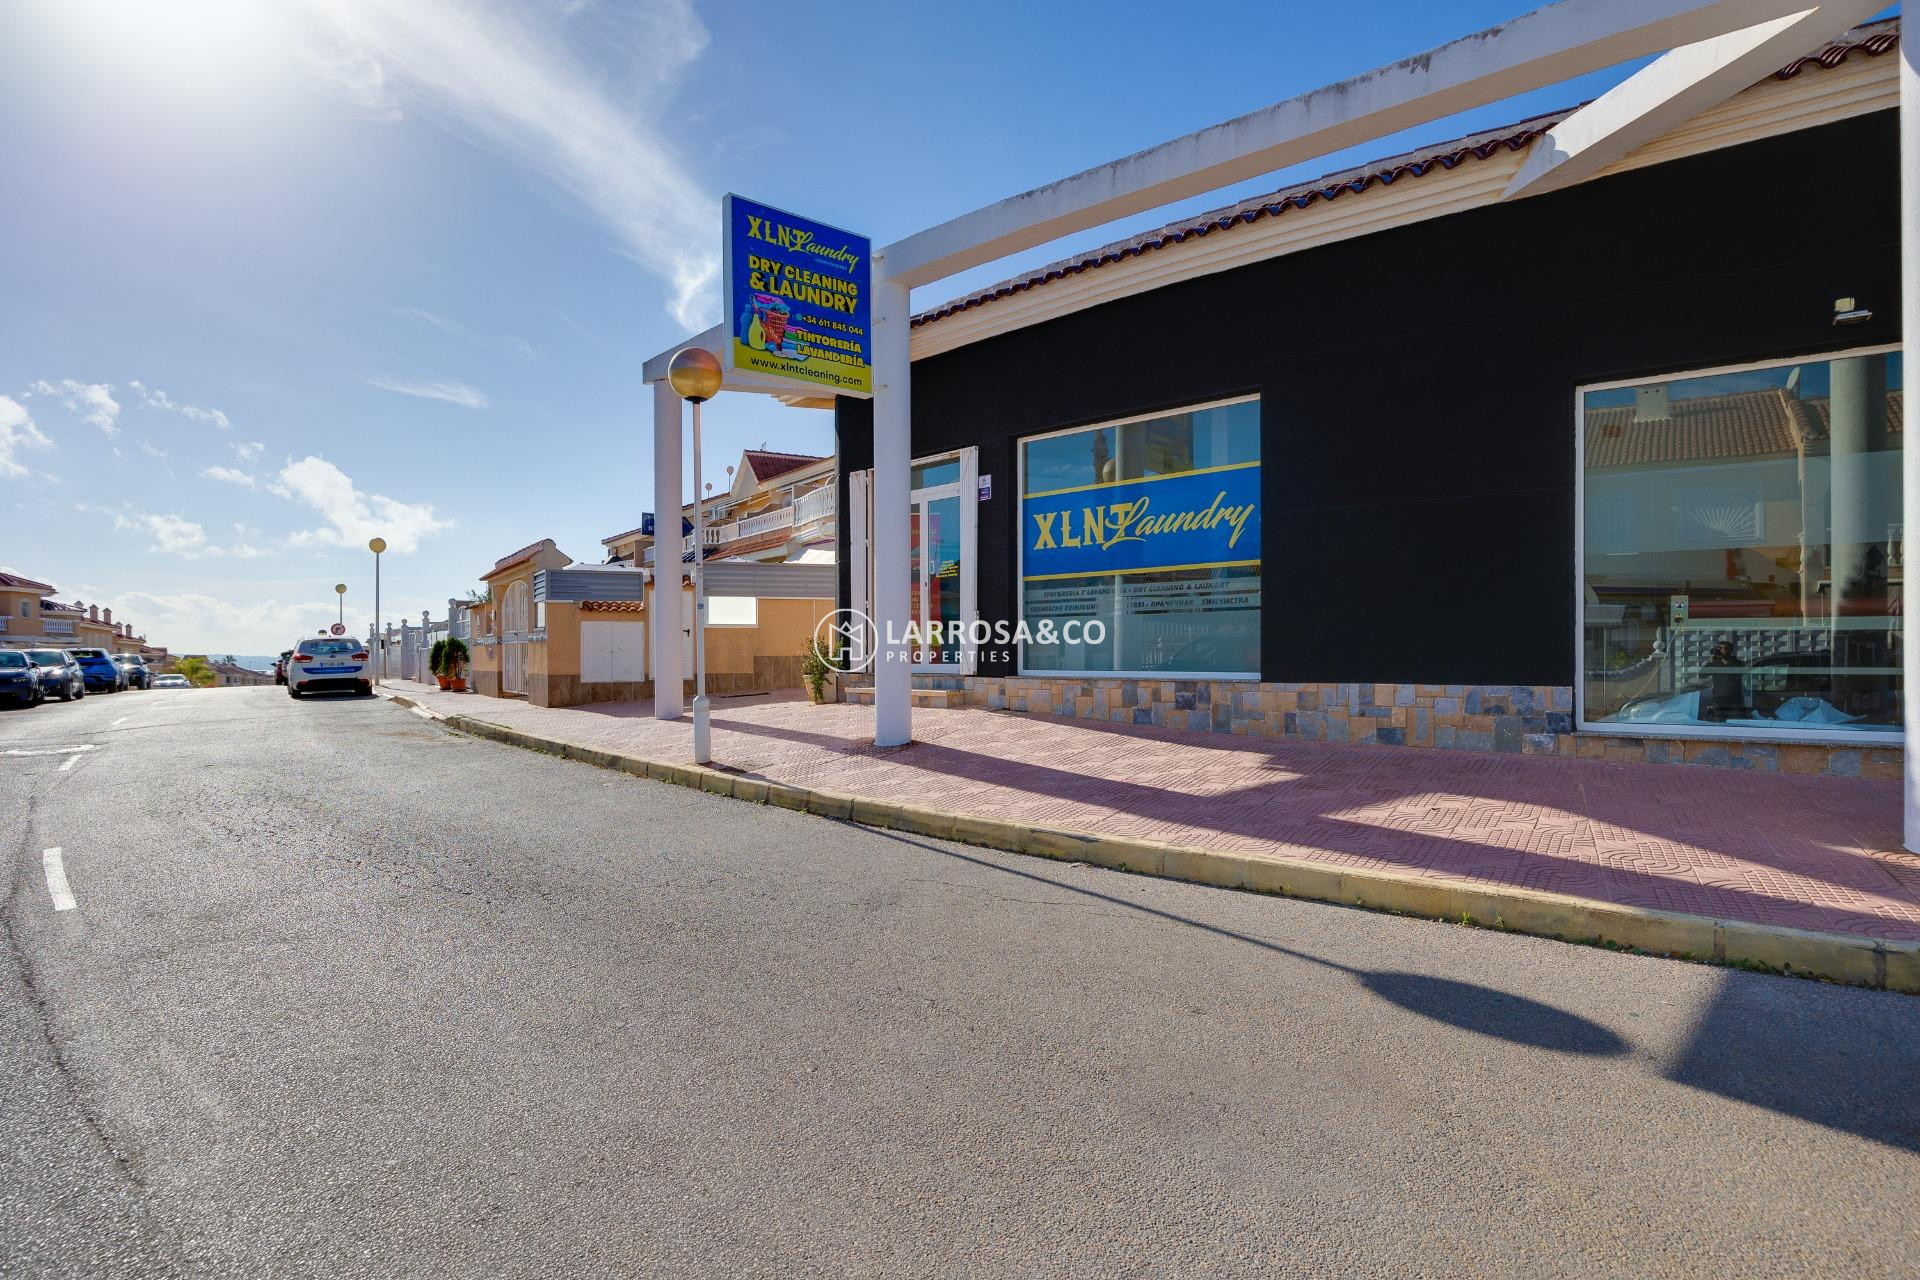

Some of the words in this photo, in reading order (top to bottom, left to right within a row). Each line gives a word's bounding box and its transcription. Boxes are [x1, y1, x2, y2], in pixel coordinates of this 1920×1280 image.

[788, 231, 859, 274] Laundry
[749, 255, 781, 275] DRY
[784, 265, 858, 296] CLEANING
[749, 271, 765, 291] &
[769, 276, 858, 314] LAUNDRY
[803, 315, 817, 325] +34
[818, 319, 830, 328] 611
[832, 321, 847, 332] 845
[848, 325, 864, 336] 044
[797, 329, 862, 353] TINTORERÍA
[797, 344, 865, 368] LAVANDERÍA
[750, 357, 862, 386] www.xlntcleaning.com
[1033, 501, 1134, 551] XLNT
[1102, 490, 1255, 551] Laundry
[1149, 583, 1185, 592] CLEANING
[1064, 603, 1099, 612] REINIGUN
